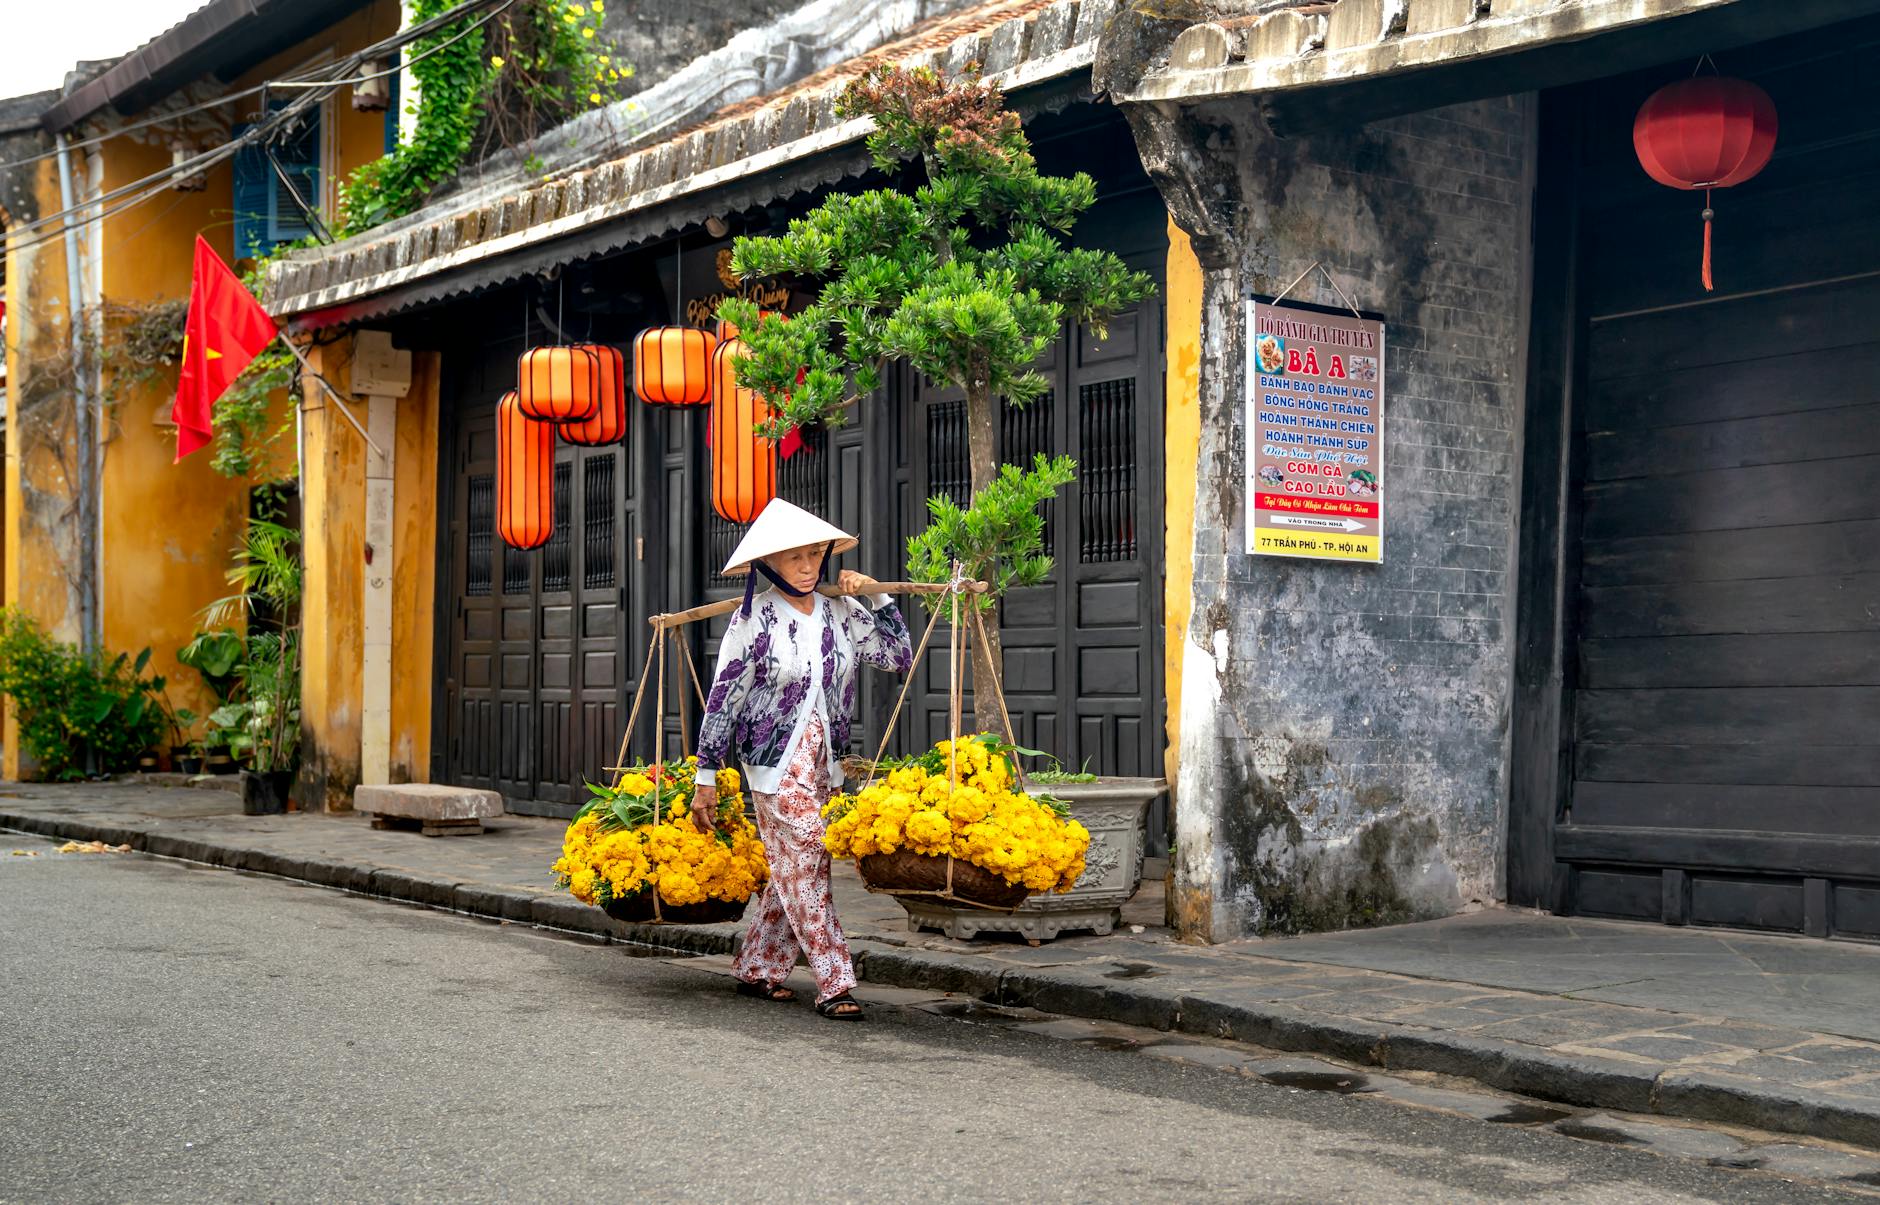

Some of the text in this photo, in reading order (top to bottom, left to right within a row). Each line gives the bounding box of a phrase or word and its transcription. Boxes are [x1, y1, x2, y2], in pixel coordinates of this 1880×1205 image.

[753, 280, 790, 310] Quảng
[1276, 314, 1306, 340] BÁNH
[1309, 324, 1328, 343] GIA
[1287, 346, 1346, 378] BÀ A
[1260, 376, 1374, 403] BÁNH BAO BÁNH VẠC
[1265, 394, 1369, 416] BÔNG HỒNG TRẮNG
[1260, 410, 1374, 434] HOÀNH THÁNH CHIÊN
[1266, 429, 1368, 450] HOÀNH THÁNH SÚP
[1287, 461, 1342, 477] CƠM GÀ
[1285, 479, 1346, 496] CAO LẦU
[1262, 538, 1271, 546] 77
[1274, 536, 1297, 548] TRẦN
[1299, 539, 1316, 549] PHÚ
[1323, 542, 1336, 551] TP.
[1338, 541, 1354, 555] HỘI
[1356, 544, 1368, 553] AN
